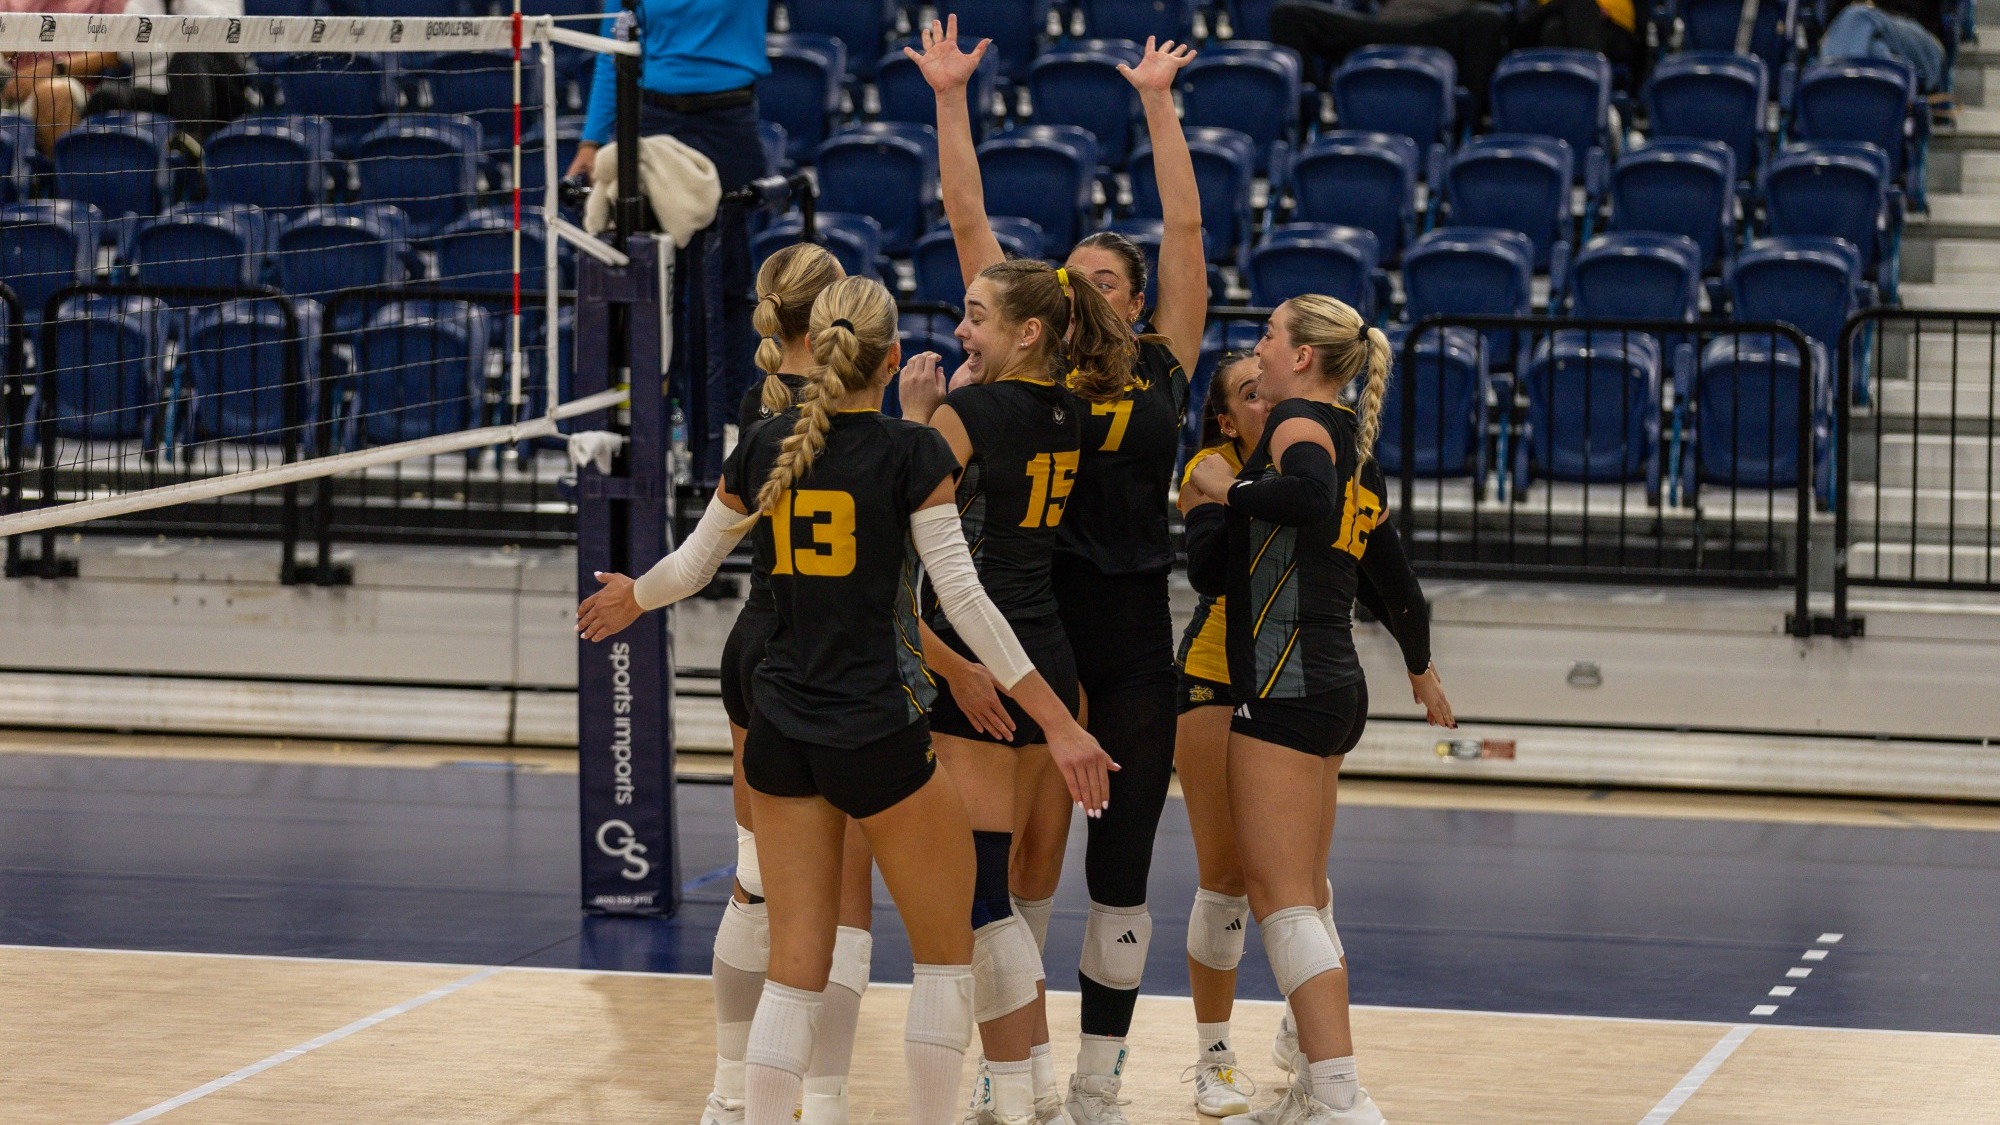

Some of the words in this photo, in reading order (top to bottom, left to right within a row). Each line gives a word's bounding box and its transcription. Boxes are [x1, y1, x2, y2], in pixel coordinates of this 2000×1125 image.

[87, 15, 108, 42] Eagles
[1091, 399, 1134, 451] 7
[1019, 449, 1080, 528] 15
[1331, 476, 1382, 560] 12
[762, 489, 857, 577] 13
[608, 641, 634, 714] sports
[610, 716, 635, 806] imports
